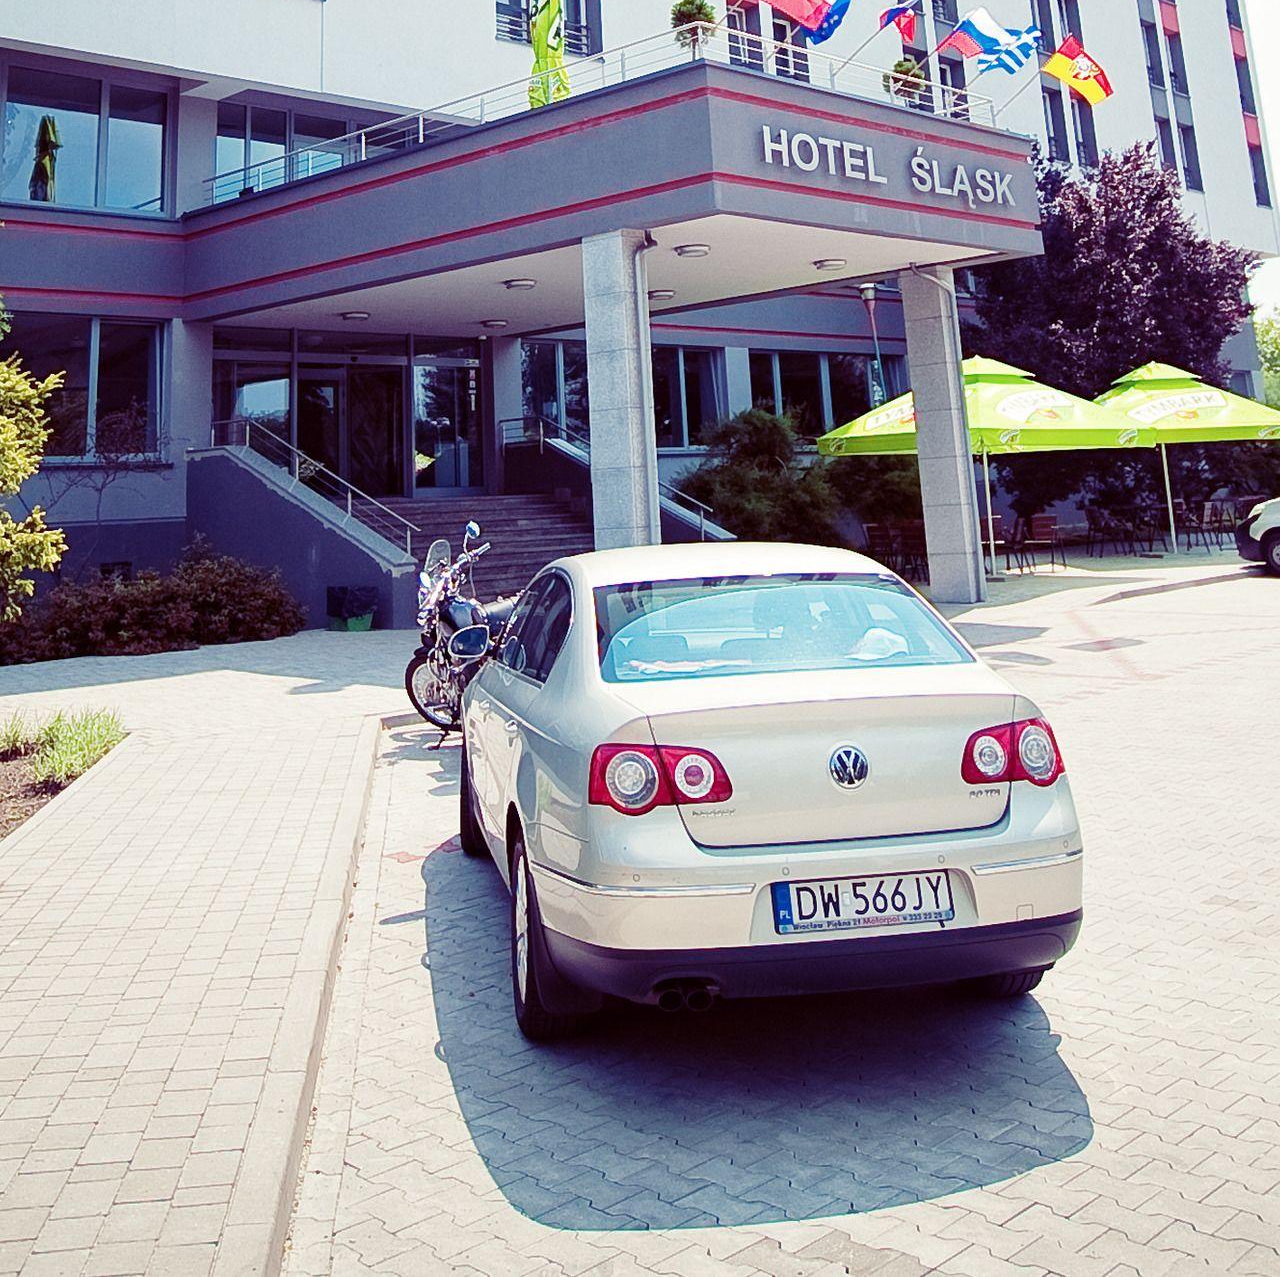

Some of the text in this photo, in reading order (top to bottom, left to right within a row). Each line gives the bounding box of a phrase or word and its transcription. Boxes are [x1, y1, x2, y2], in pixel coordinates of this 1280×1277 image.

[762, 125, 1017, 210] HOTEL ŚLĄSK
[796, 875, 942, 921] DW 566JY
[779, 910, 791, 920] PL
[862, 913, 901, 926] Motorpol
